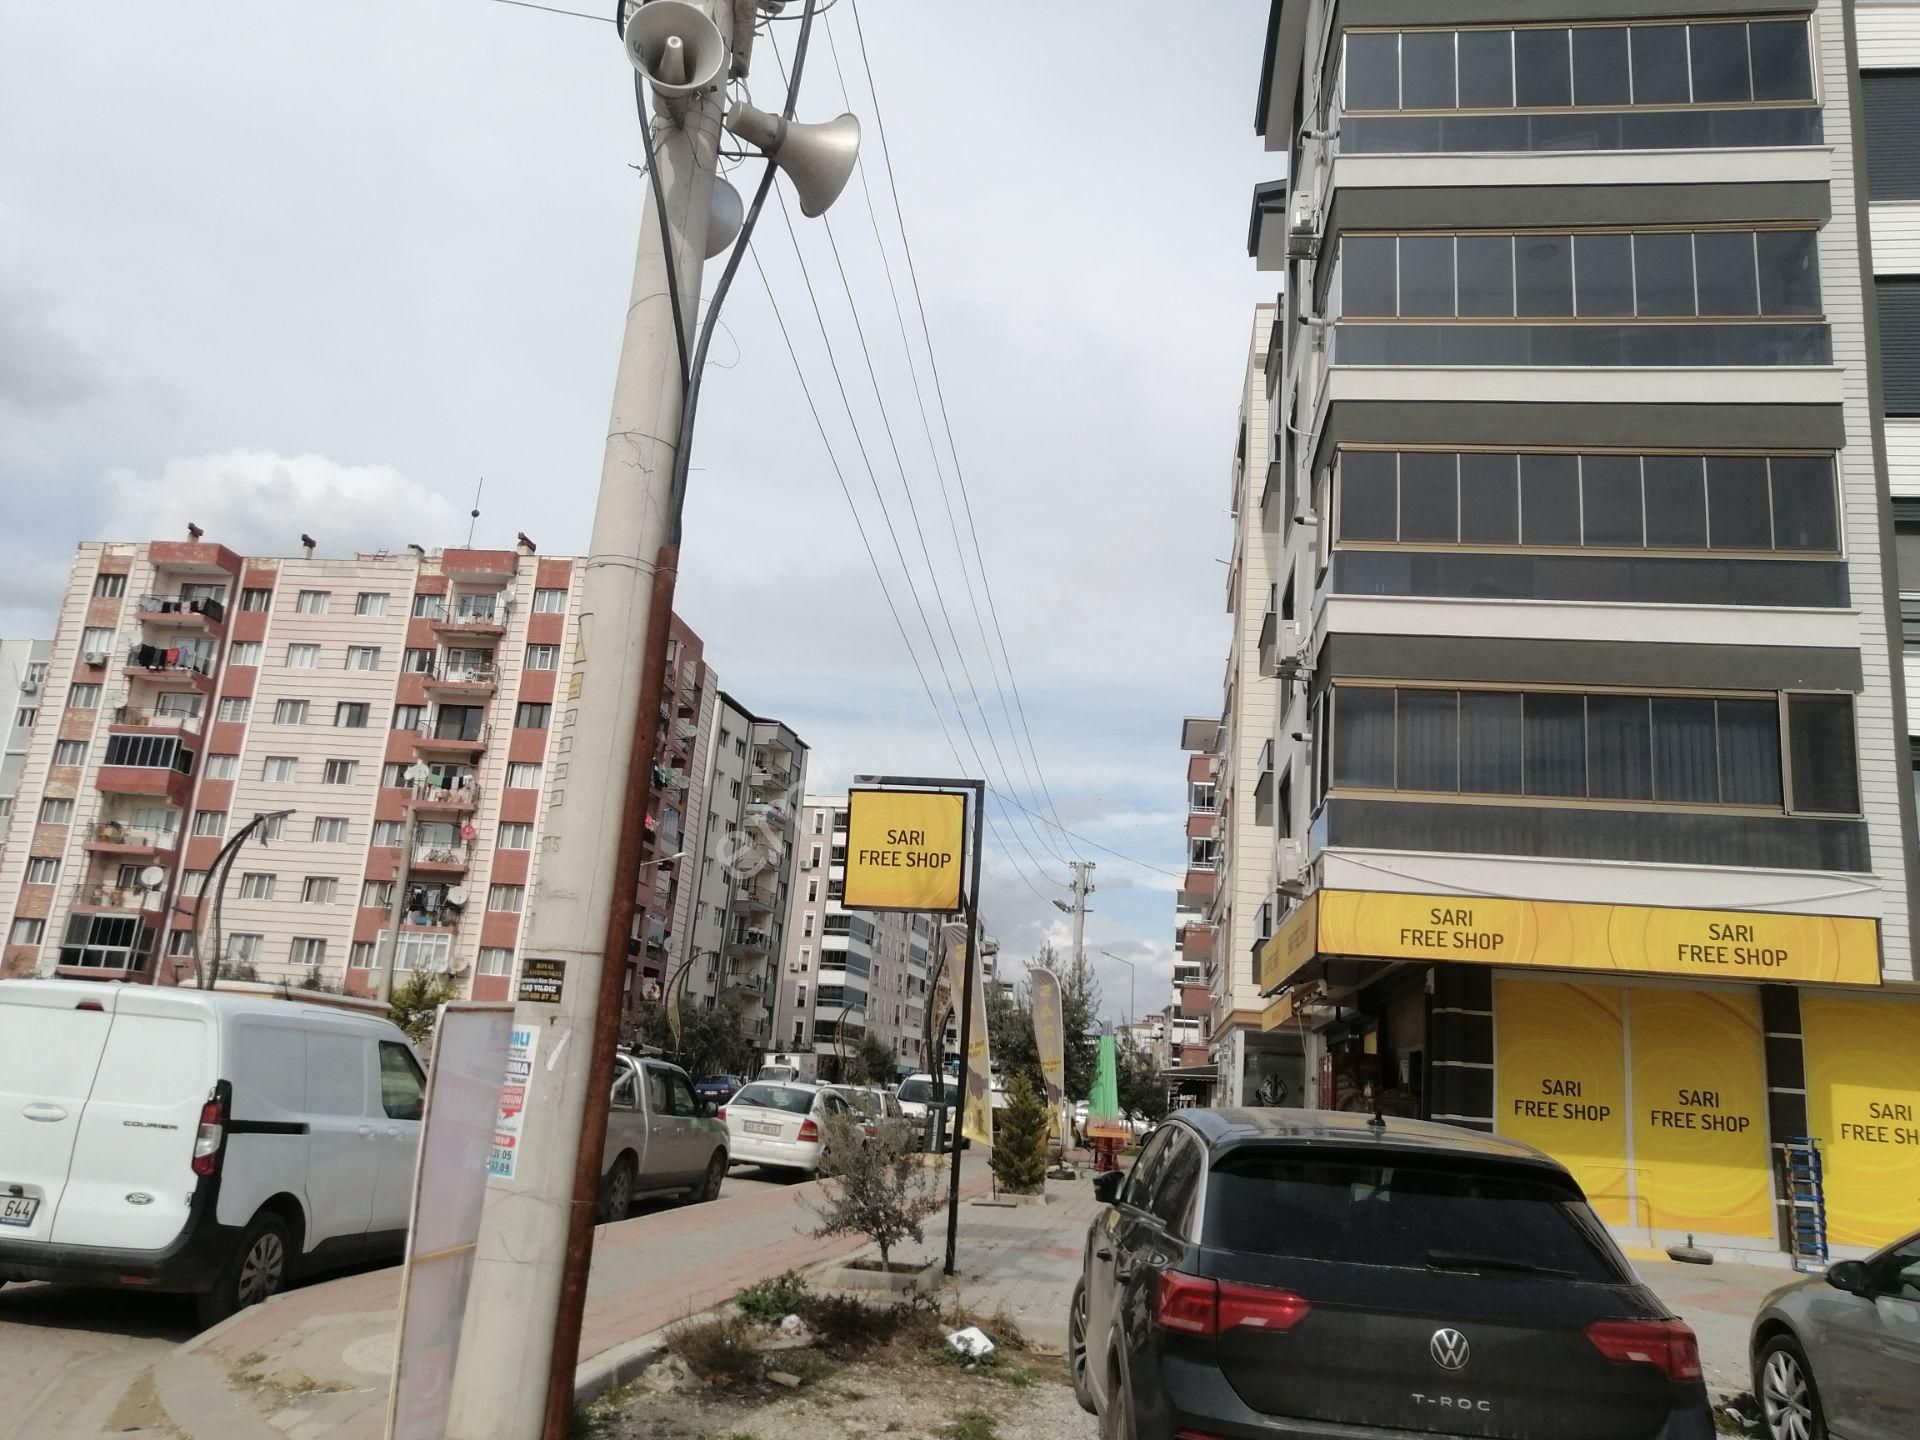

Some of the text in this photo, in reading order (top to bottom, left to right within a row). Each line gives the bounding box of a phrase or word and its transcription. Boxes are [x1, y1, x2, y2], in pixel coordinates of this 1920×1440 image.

[886, 829, 925, 846] SARI
[859, 850, 952, 868] FREE SHOP
[1430, 908, 1473, 927] SARI
[1400, 928, 1504, 950] FREE SHOP
[1708, 923, 1754, 942] SARI
[1678, 943, 1788, 967] FREE SHOP
[1542, 1078, 1582, 1097] SARI
[1679, 1089, 1720, 1108] SARI
[1514, 1099, 1611, 1121] FREE SHOP
[1869, 1102, 1913, 1121] SARI
[123, 1120, 179, 1130] COURIER
[1651, 1110, 1750, 1133] FREE SHOP
[1840, 1123, 1889, 1143] FREE
[501, 1150, 513, 1161] 05
[4, 1200, 31, 1219] 644
[1412, 1393, 1491, 1412] T-ROC
